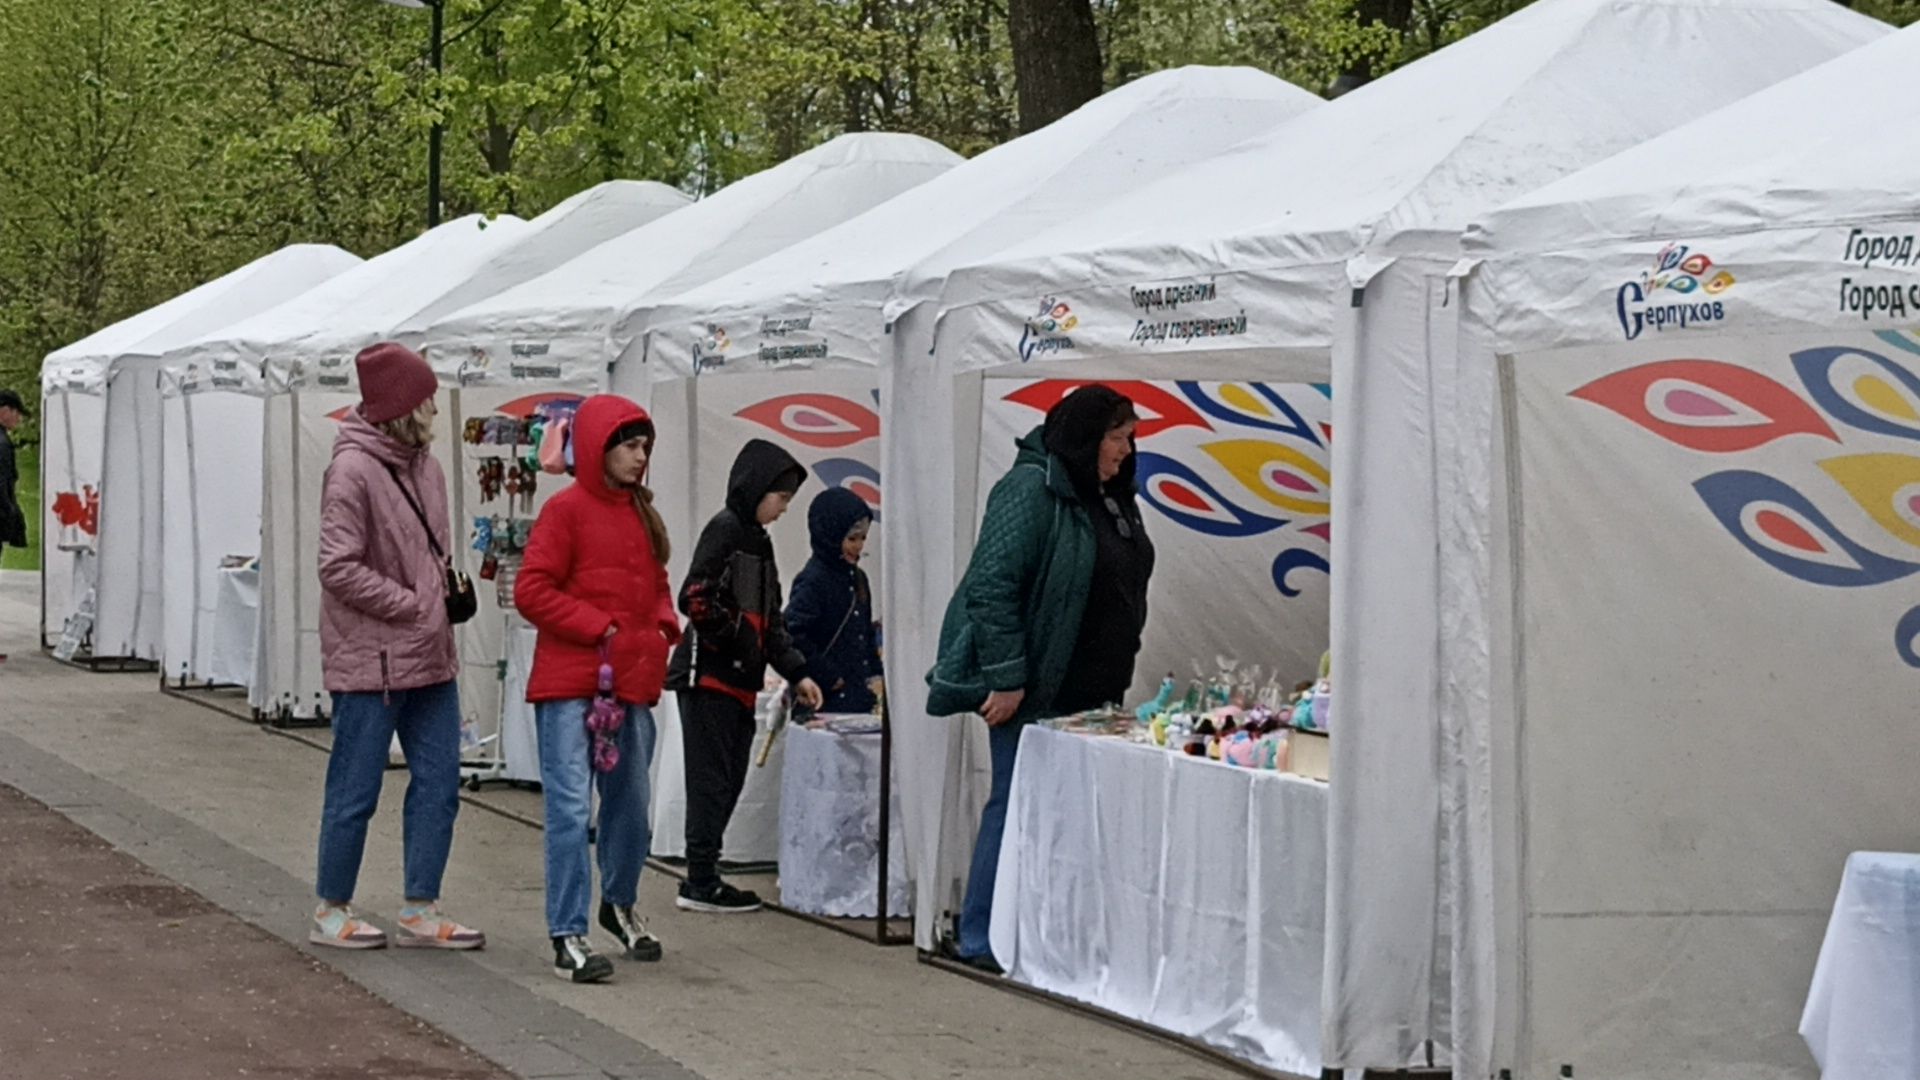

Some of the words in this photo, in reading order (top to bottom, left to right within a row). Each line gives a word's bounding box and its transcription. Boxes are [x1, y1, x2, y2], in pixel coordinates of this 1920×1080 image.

[1844, 228, 1914, 269] Город
[1130, 286, 1165, 314] Город
[1617, 281, 1724, 340] Серпухов
[1840, 278, 1906, 320] Город
[1130, 320, 1168, 346] Город
